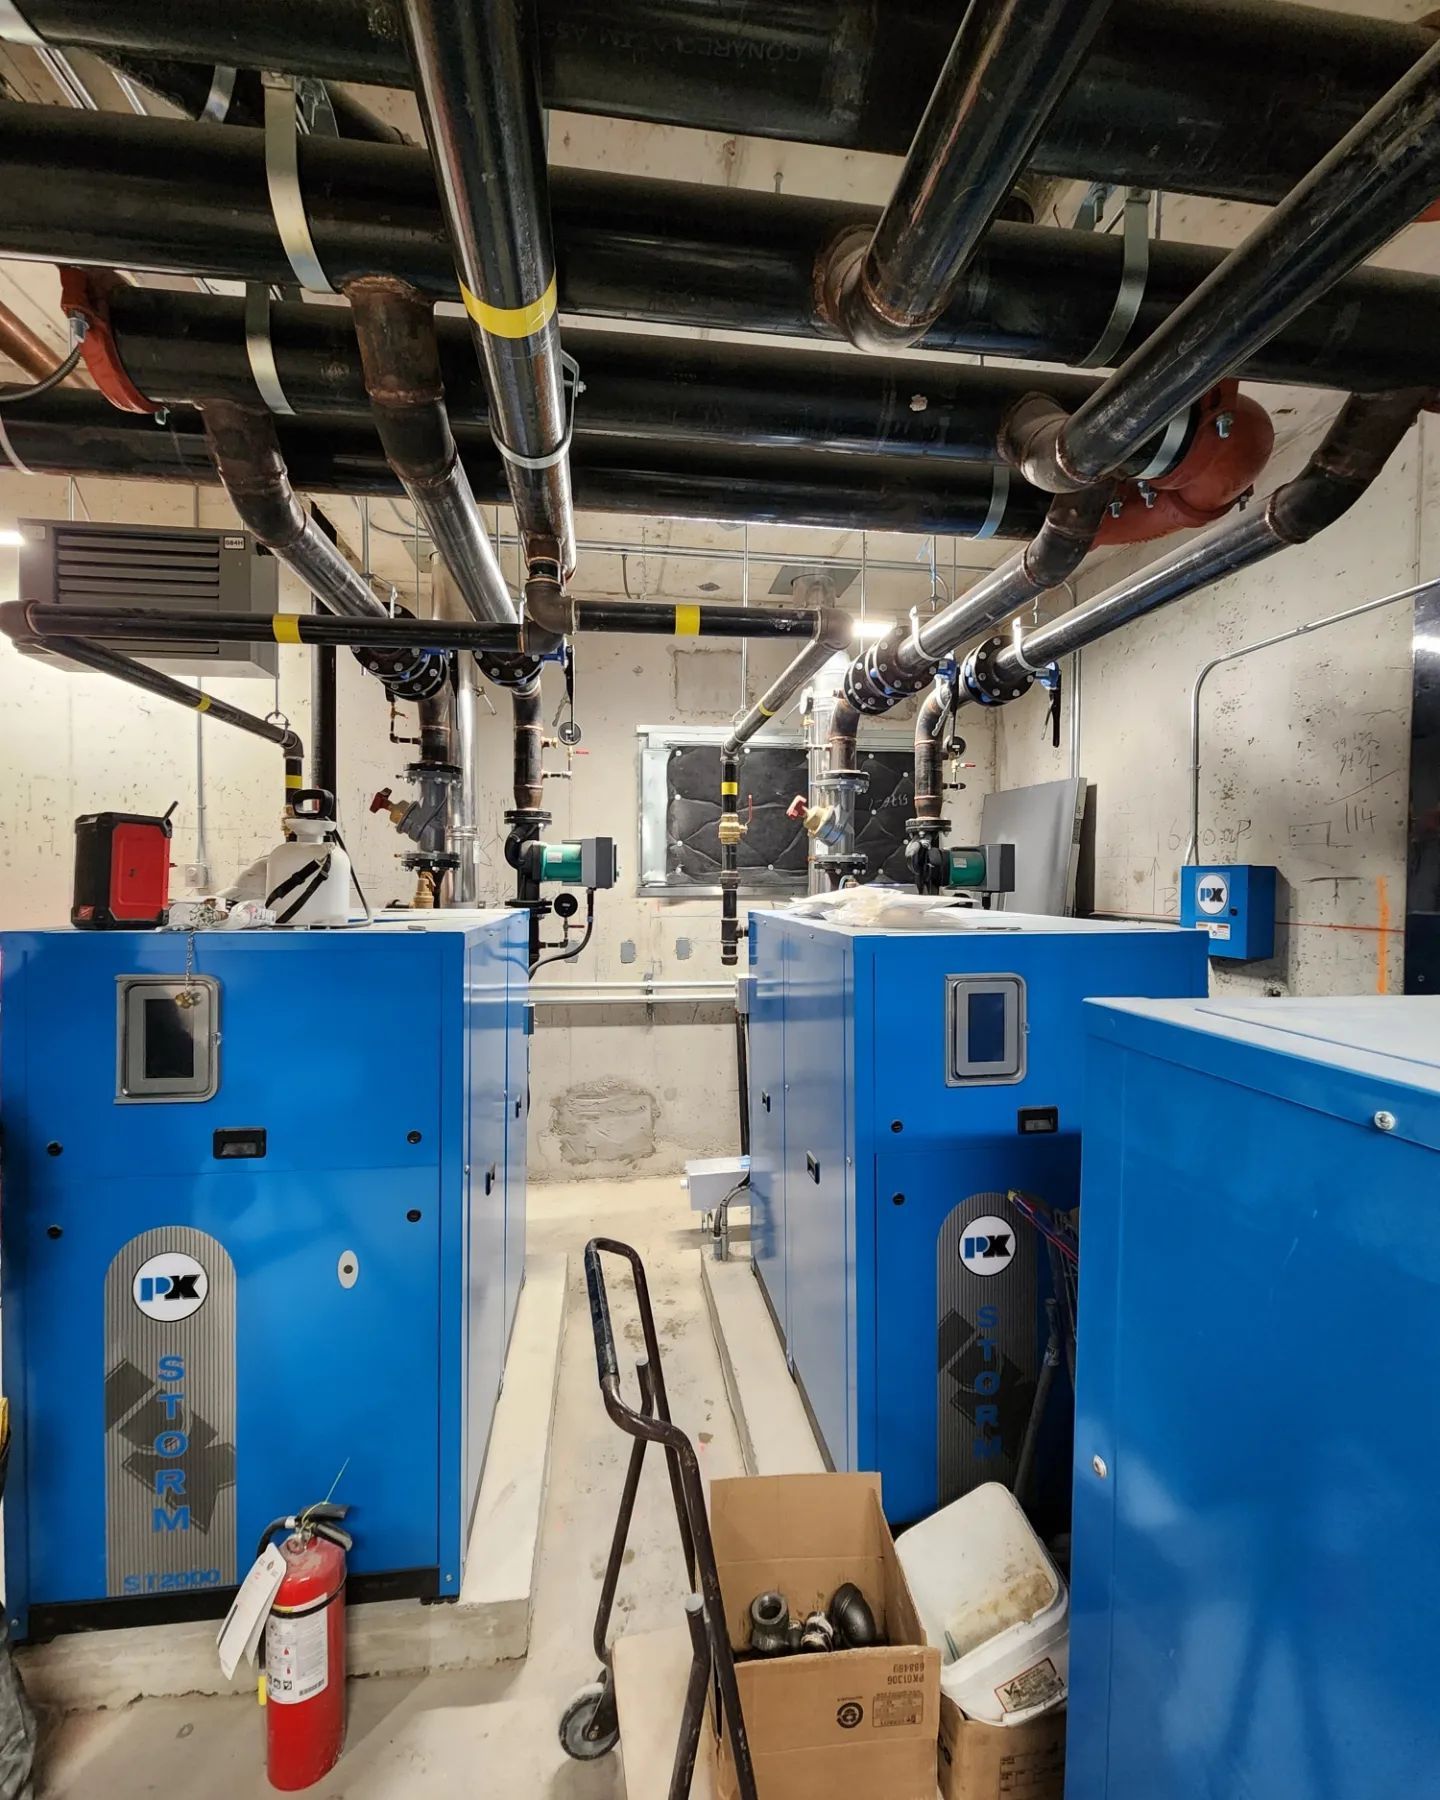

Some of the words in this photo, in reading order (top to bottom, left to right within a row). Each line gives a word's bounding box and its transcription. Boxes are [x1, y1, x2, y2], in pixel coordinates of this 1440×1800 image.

[140, 1274, 201, 1303] PK
[972, 1304, 1002, 1462] STORM
[152, 1354, 190, 1533] STORM
[123, 1567, 222, 1593] ST2000
